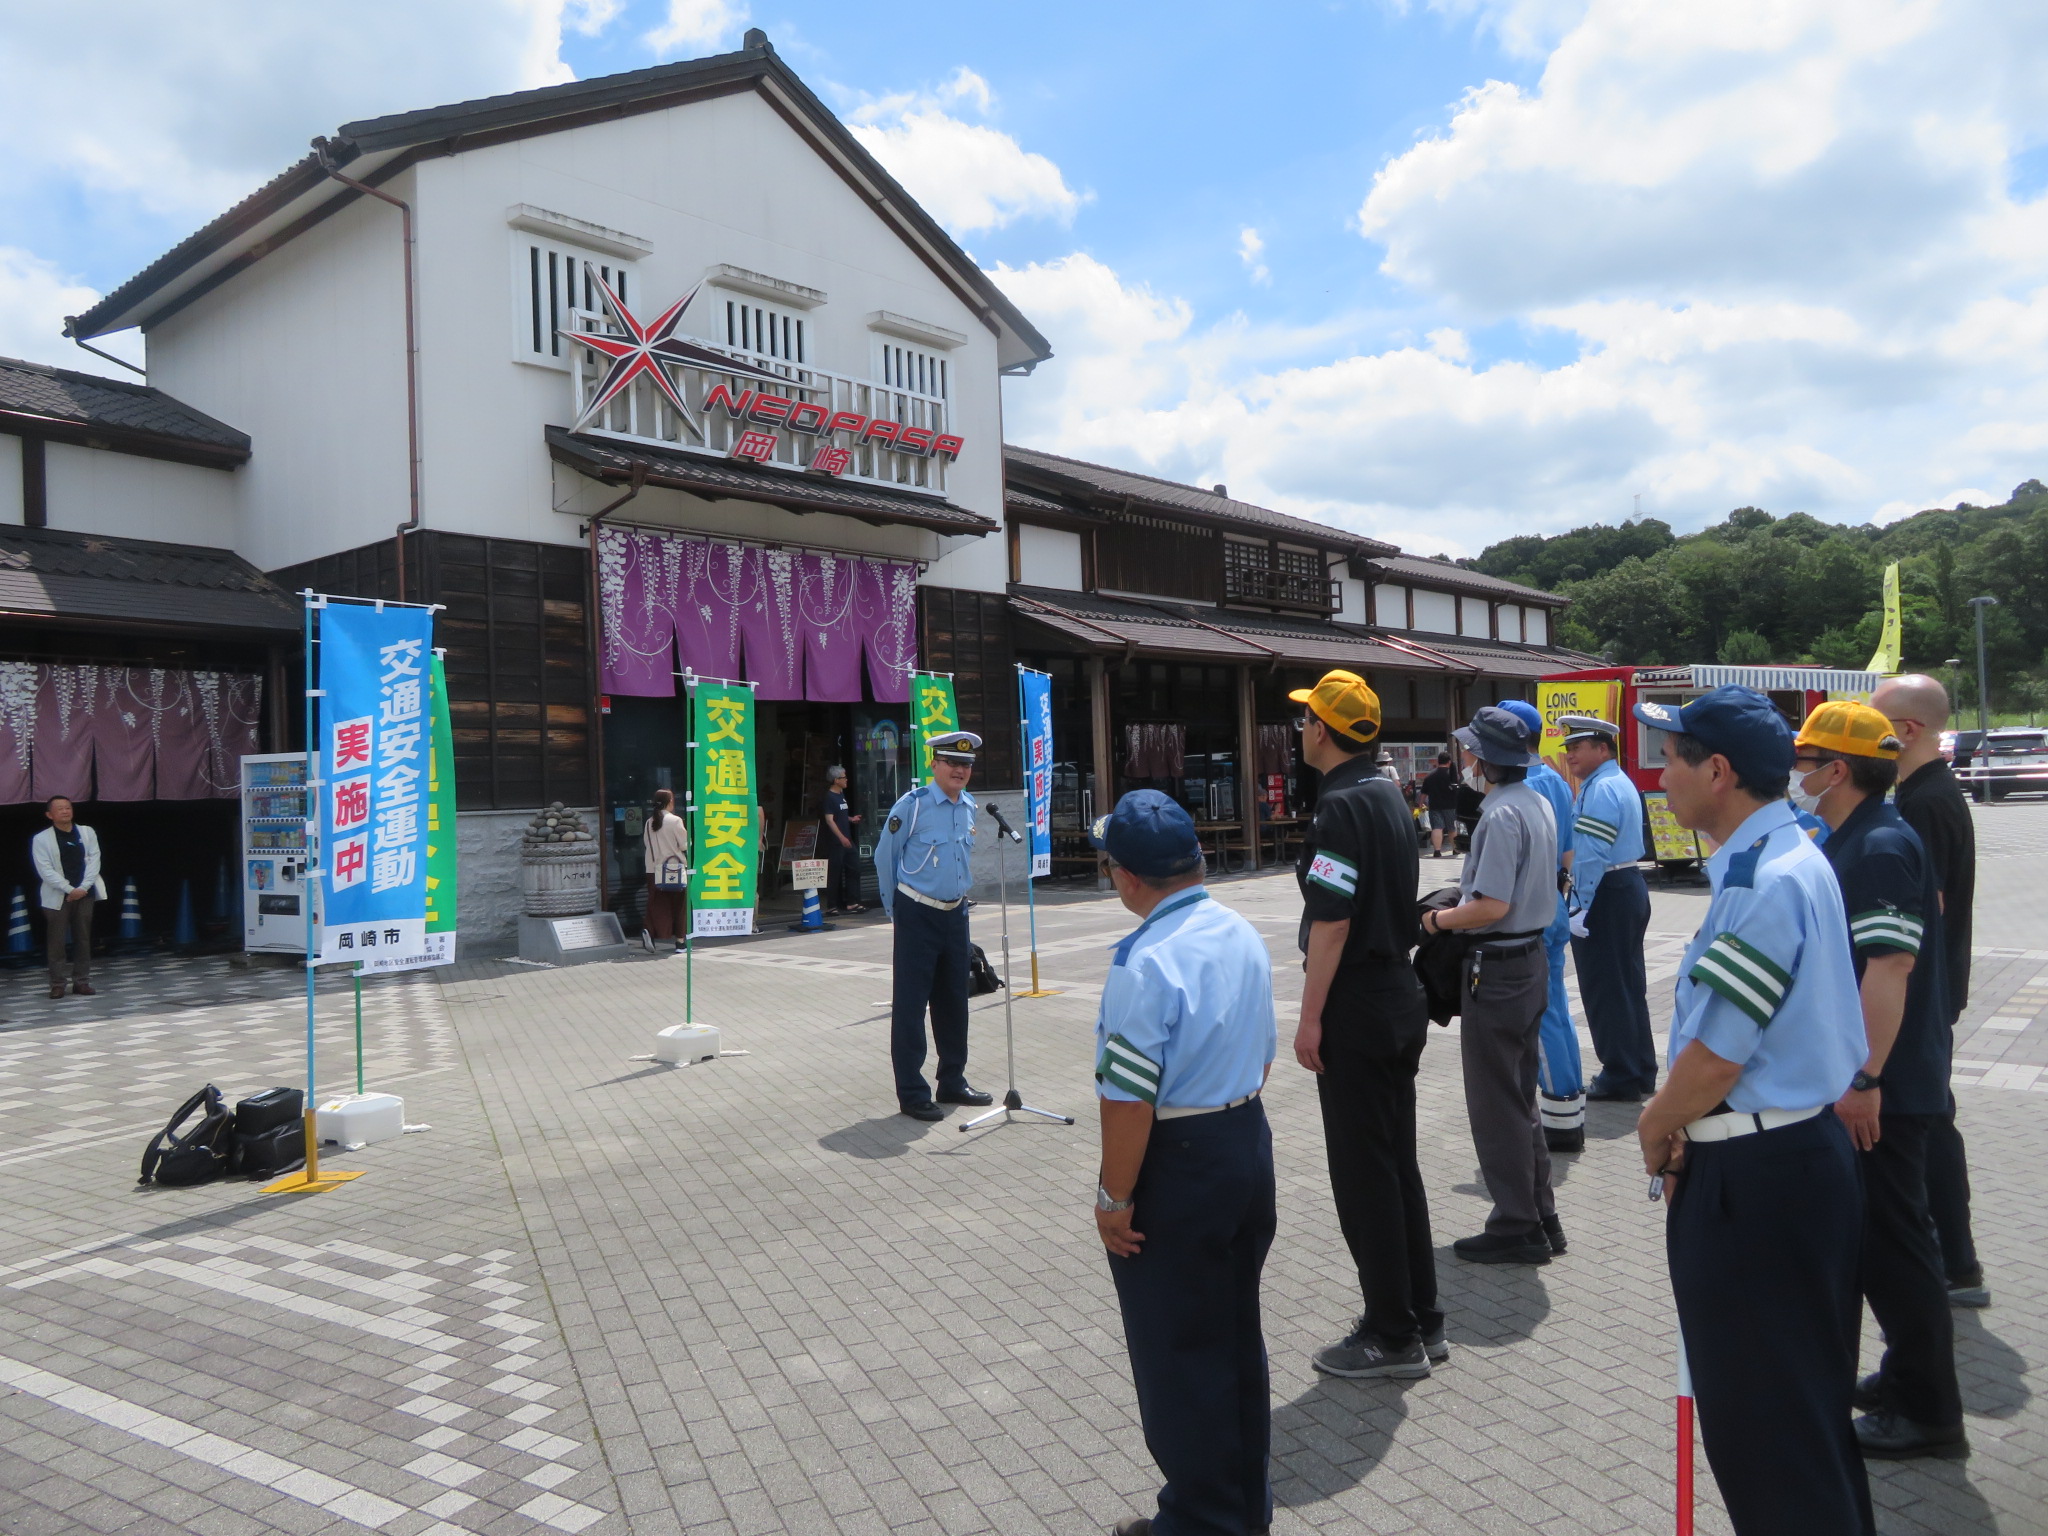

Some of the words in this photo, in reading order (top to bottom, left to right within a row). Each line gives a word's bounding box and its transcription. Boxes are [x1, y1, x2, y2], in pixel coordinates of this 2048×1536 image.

[701, 384, 964, 463] NEOPASA
[732, 430, 852, 476] 岡崎
[1546, 692, 1577, 709] LONG
[371, 638, 423, 895] 交通安全運動
[335, 723, 370, 883] 実施中
[700, 696, 749, 900] 交通安全
[1312, 858, 1335, 878] 安全
[339, 928, 401, 950] 岡崎市
